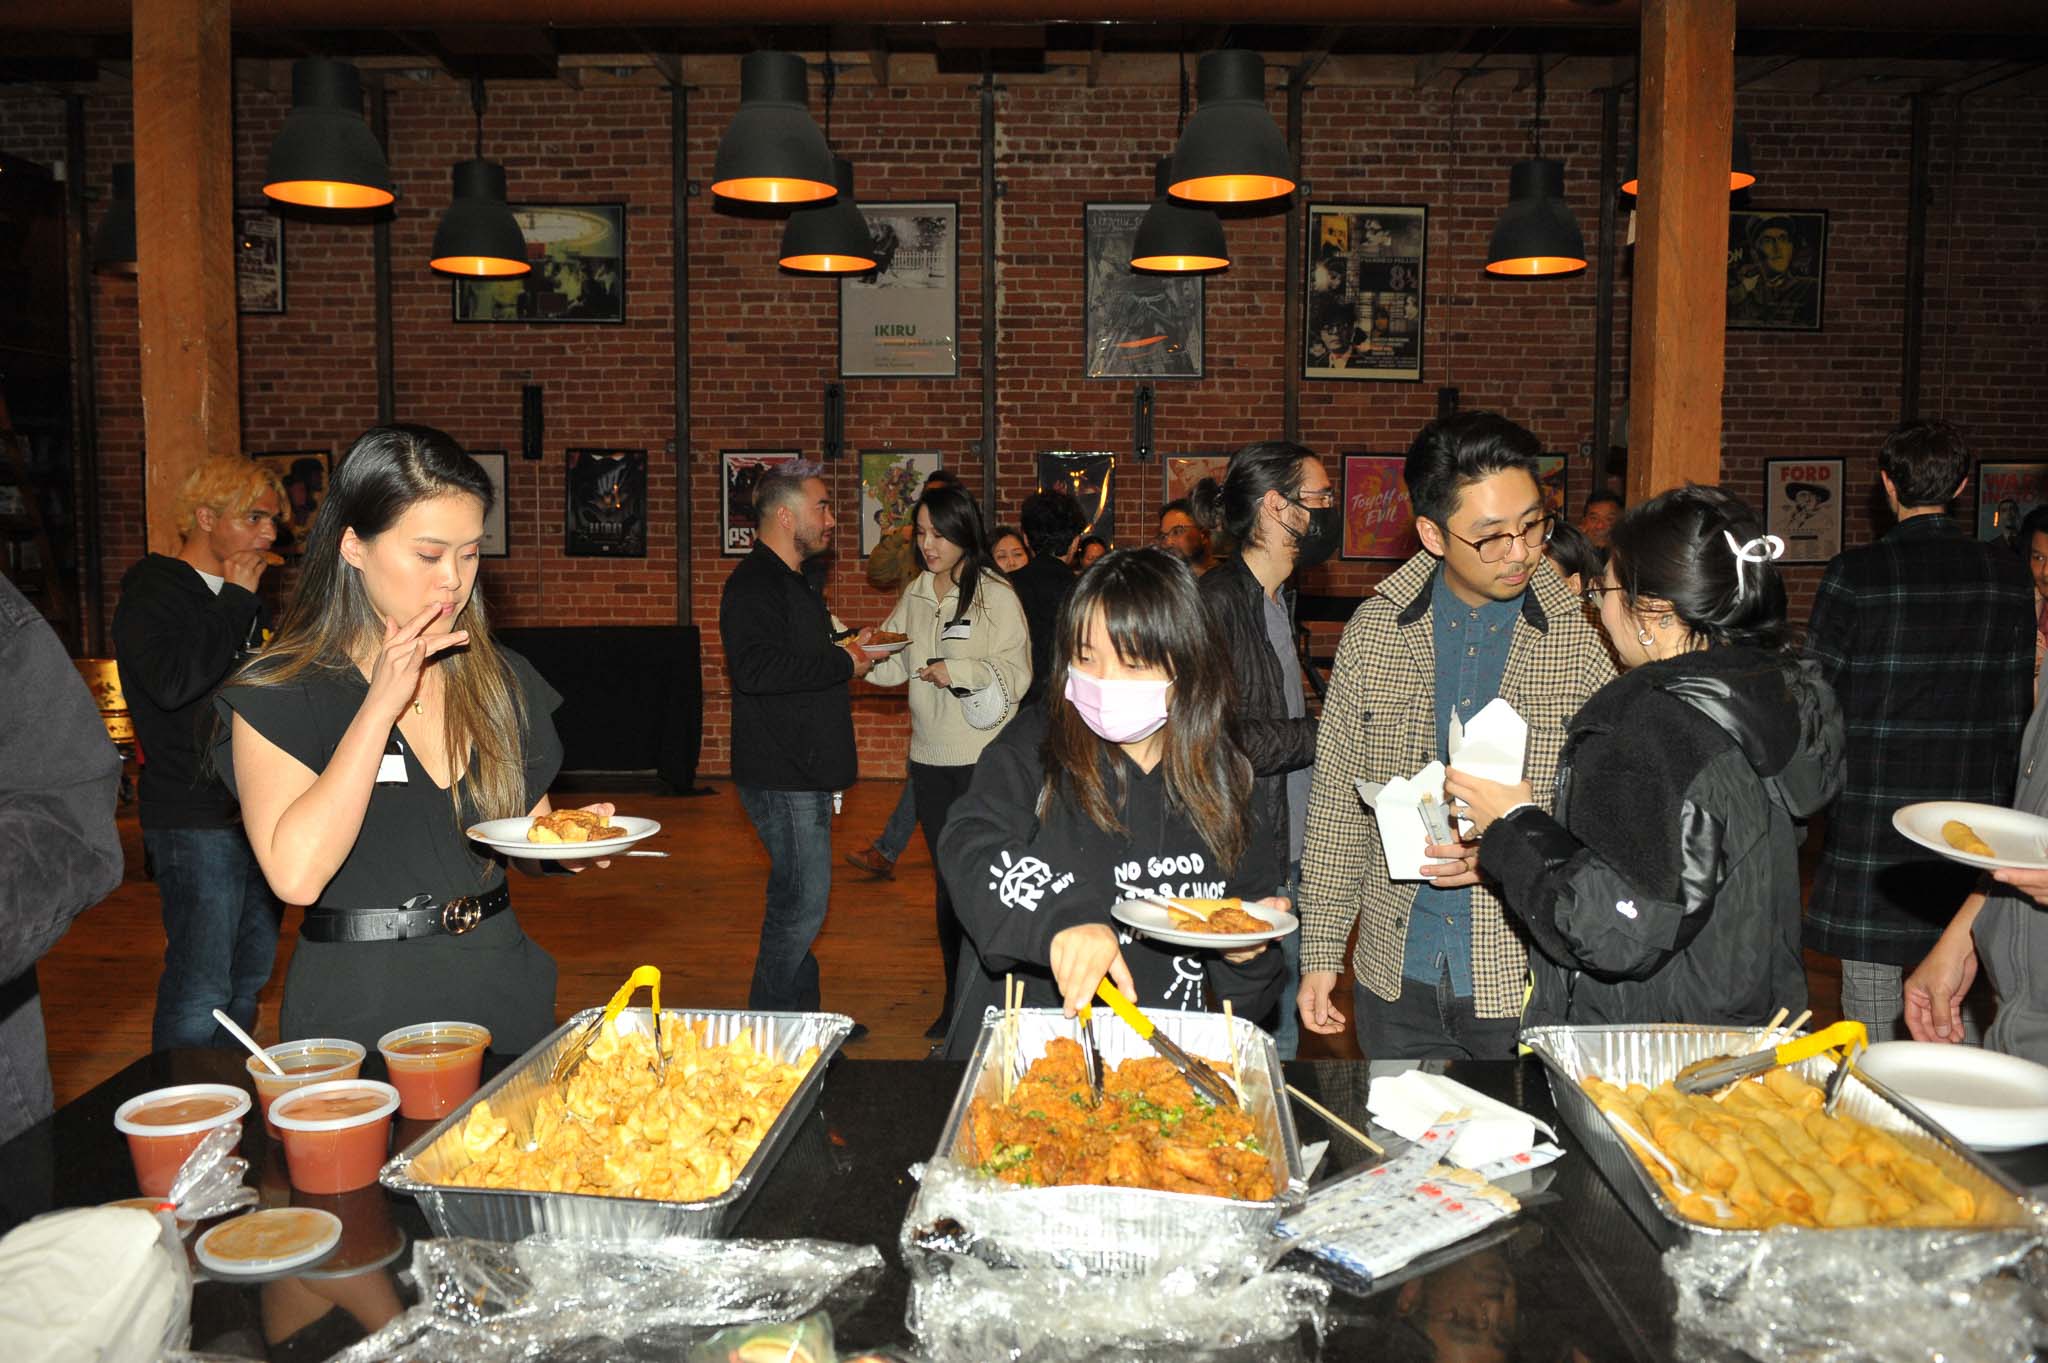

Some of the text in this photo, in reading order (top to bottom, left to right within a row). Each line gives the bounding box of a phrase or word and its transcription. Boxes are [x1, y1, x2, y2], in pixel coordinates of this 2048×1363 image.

[874, 324, 916, 337] IKIRU
[1780, 465, 1831, 481] FORD
[1114, 853, 1205, 882] NO GOOD
